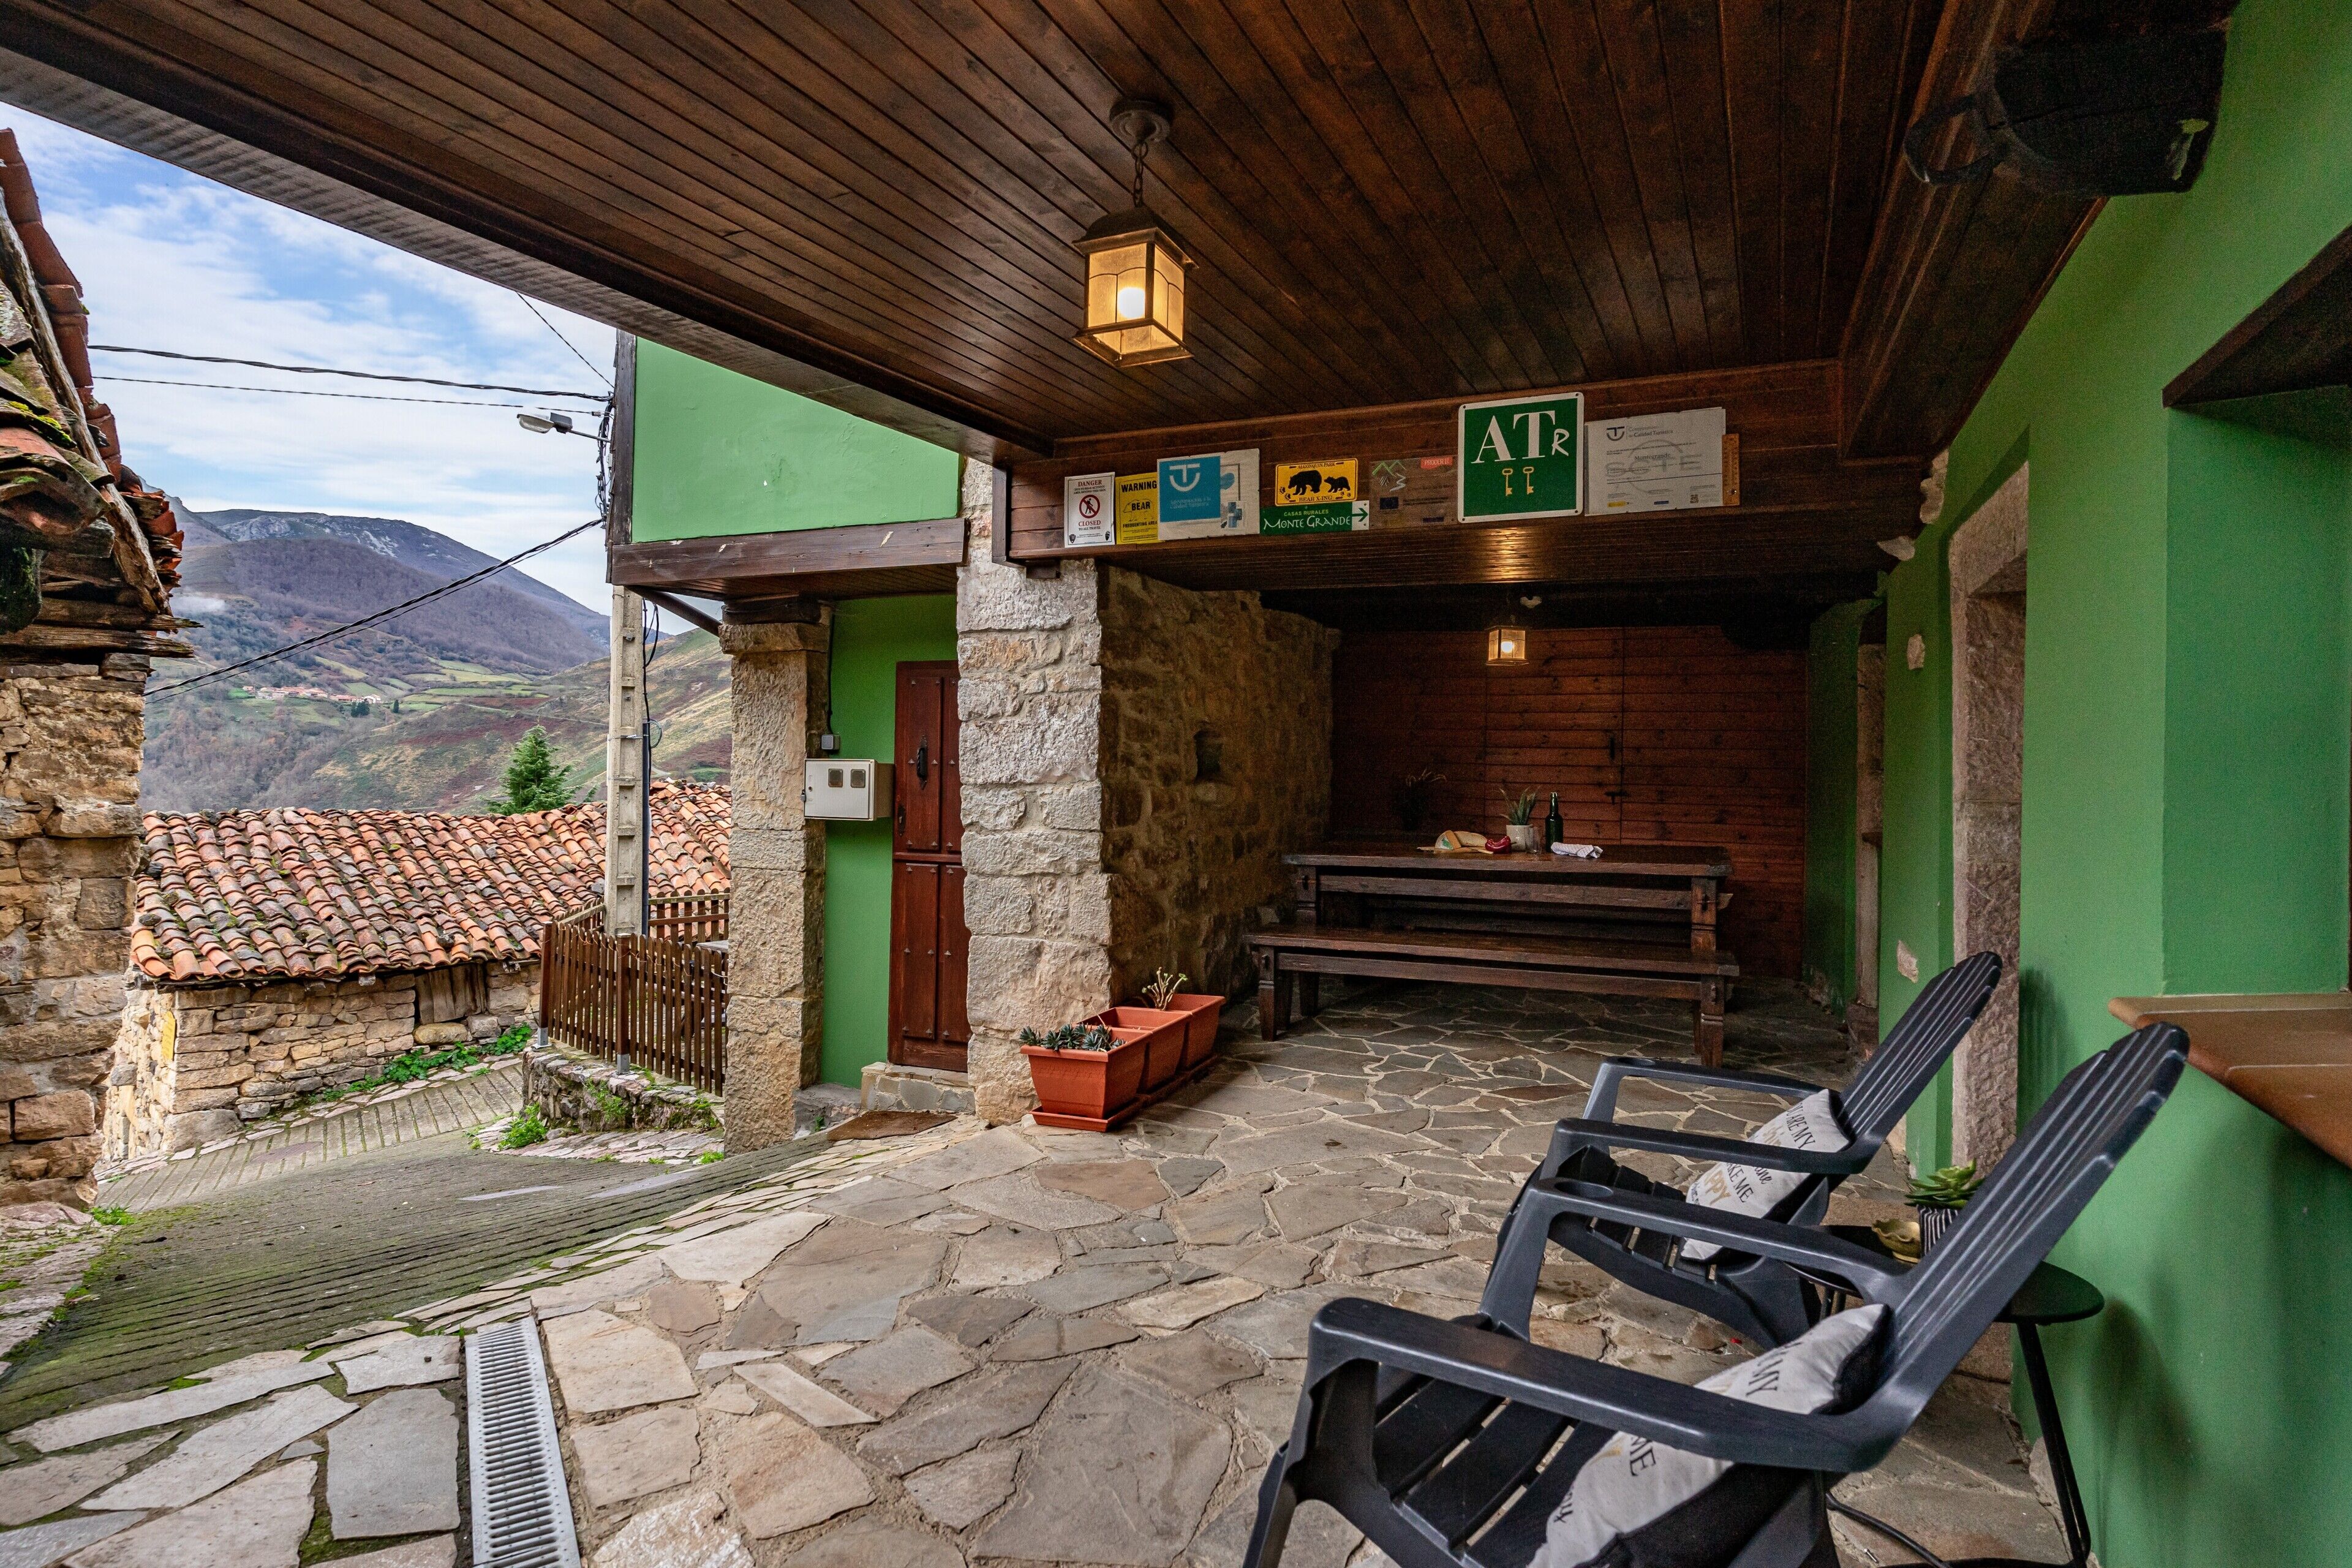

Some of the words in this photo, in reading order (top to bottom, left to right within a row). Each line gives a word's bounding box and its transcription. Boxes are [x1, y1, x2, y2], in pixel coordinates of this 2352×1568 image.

[1121, 480, 1157, 492] WARNING
[1131, 501, 1150, 511] BEAR
[1786, 1114, 1807, 1131] ARE
[1791, 1126, 1816, 1149] MY
[1733, 1177, 1754, 1203] ME
